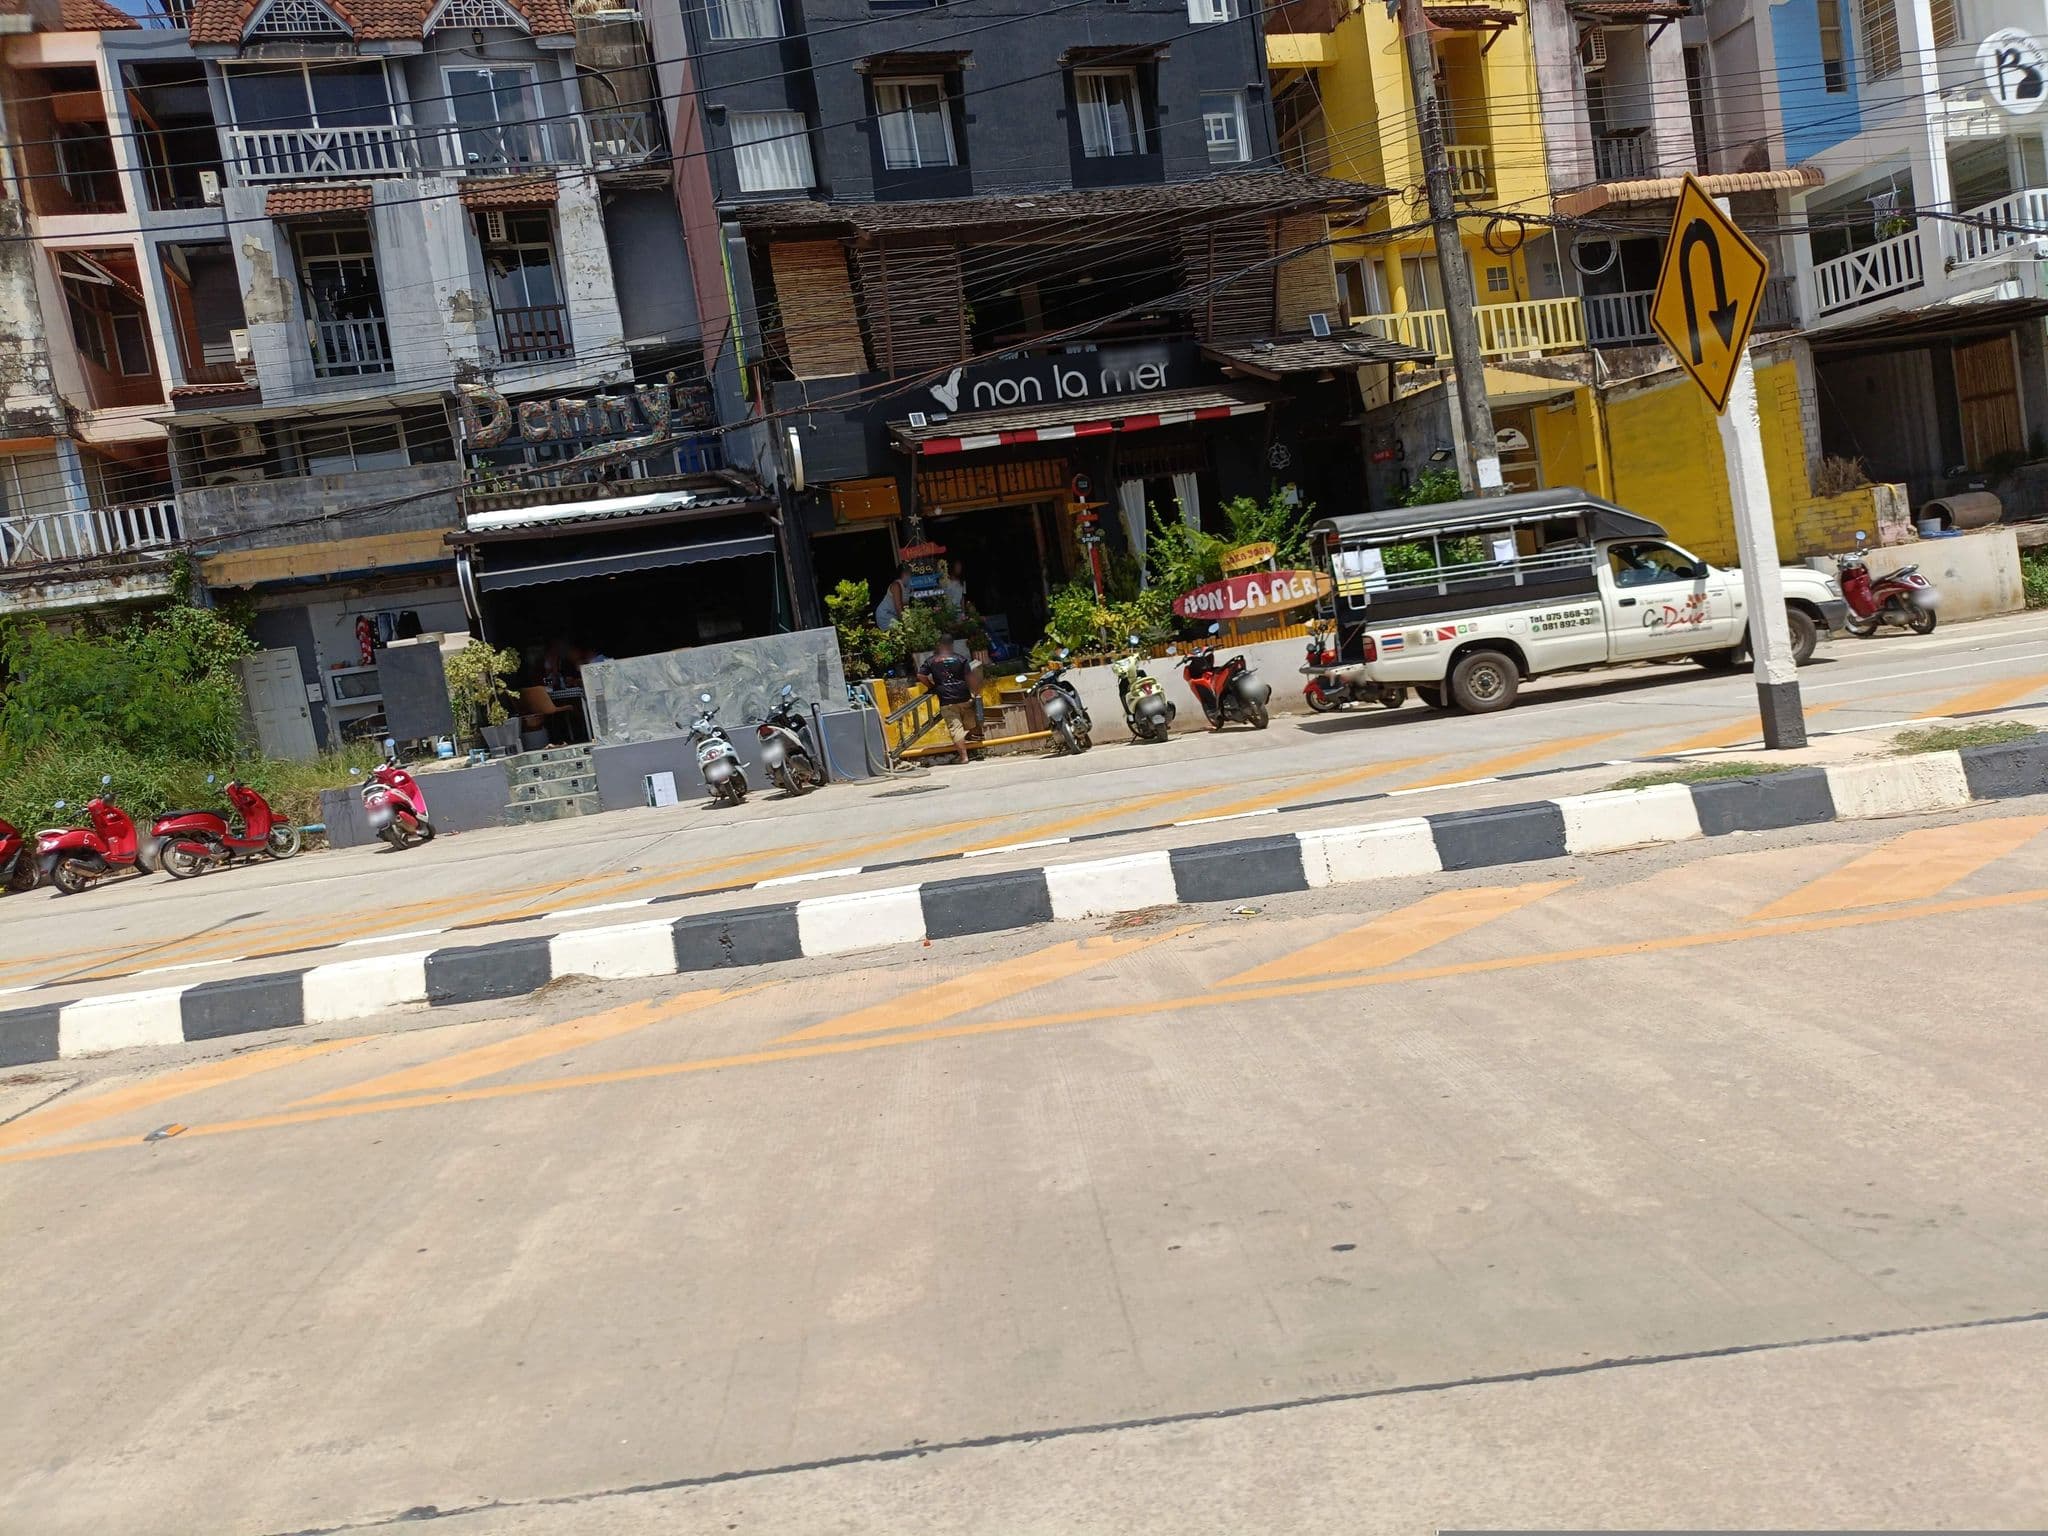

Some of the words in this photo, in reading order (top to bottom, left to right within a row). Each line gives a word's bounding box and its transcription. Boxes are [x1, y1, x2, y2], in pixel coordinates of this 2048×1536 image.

[973, 376, 1043, 408] non
[1053, 364, 1089, 399] la
[1101, 360, 1169, 394] mer
[1184, 588, 1224, 614] NON
[1227, 581, 1267, 611] LA
[1271, 577, 1317, 604] MER
[1542, 622, 1559, 631] 081
[1546, 612, 1562, 621] 075
